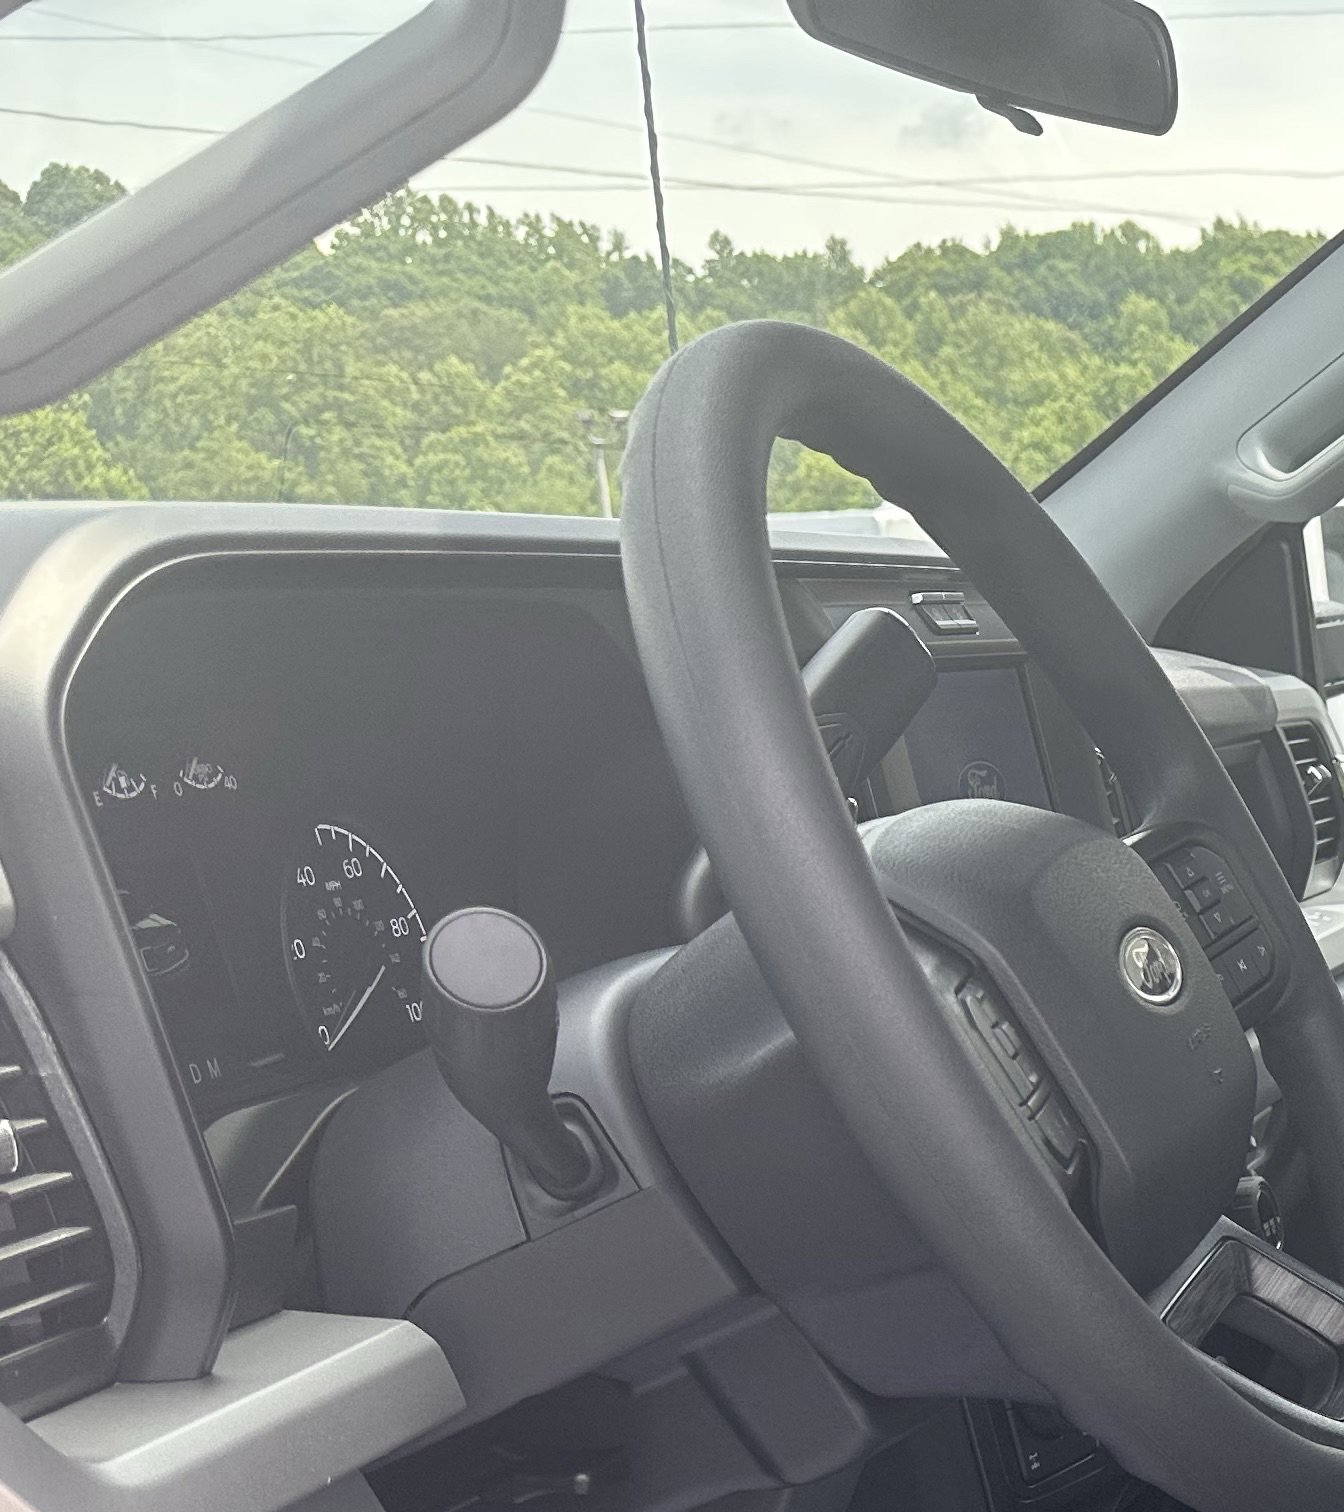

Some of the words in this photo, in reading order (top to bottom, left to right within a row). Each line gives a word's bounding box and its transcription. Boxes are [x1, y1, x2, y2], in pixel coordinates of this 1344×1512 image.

[93, 791, 103, 806] E
[297, 866, 315, 886] 40
[342, 857, 362, 878] 60
[390, 916, 409, 937] 80
[291, 939, 305, 960] 0
[406, 1001, 424, 1023] 10
[189, 1063, 202, 1084] D
[206, 1057, 222, 1079] M
